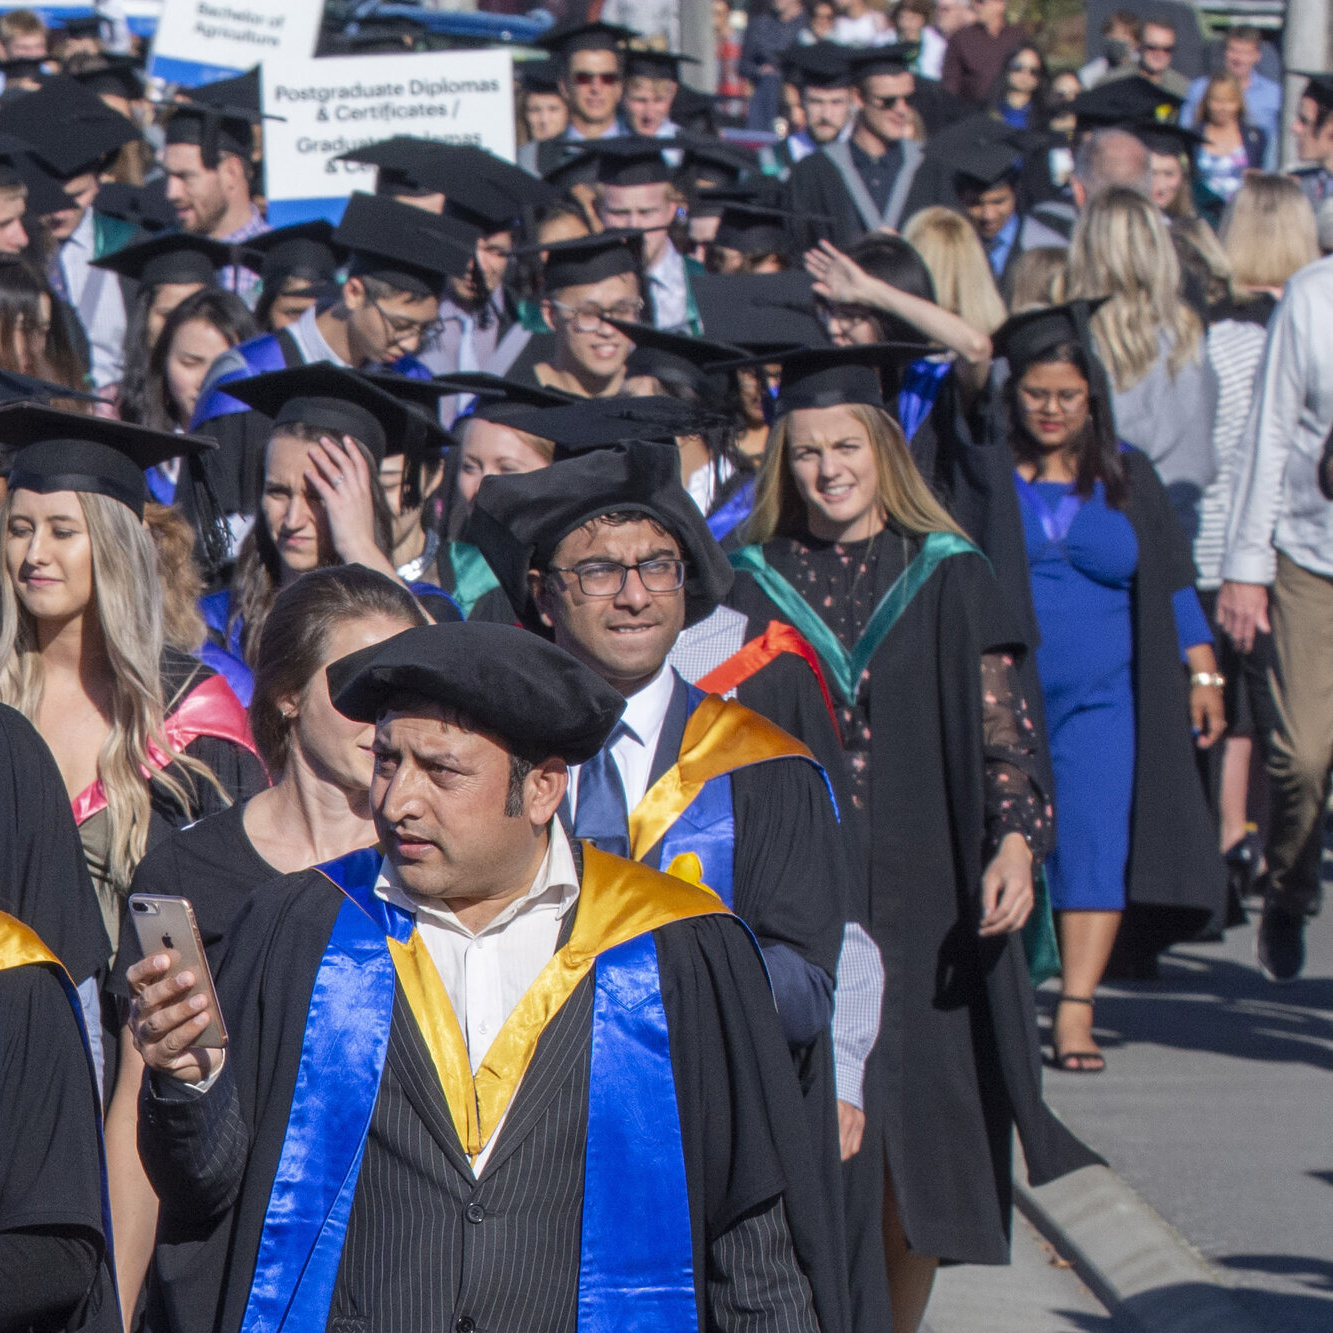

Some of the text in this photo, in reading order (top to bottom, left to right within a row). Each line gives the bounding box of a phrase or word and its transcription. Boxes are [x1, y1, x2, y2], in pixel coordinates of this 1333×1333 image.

[198, 2, 286, 28] Bachelor of
[194, 21, 280, 47] Agriculture
[275, 77, 501, 102] Postgraduate Diplomas
[316, 106, 329, 122] &
[335, 101, 449, 122] Certificates
